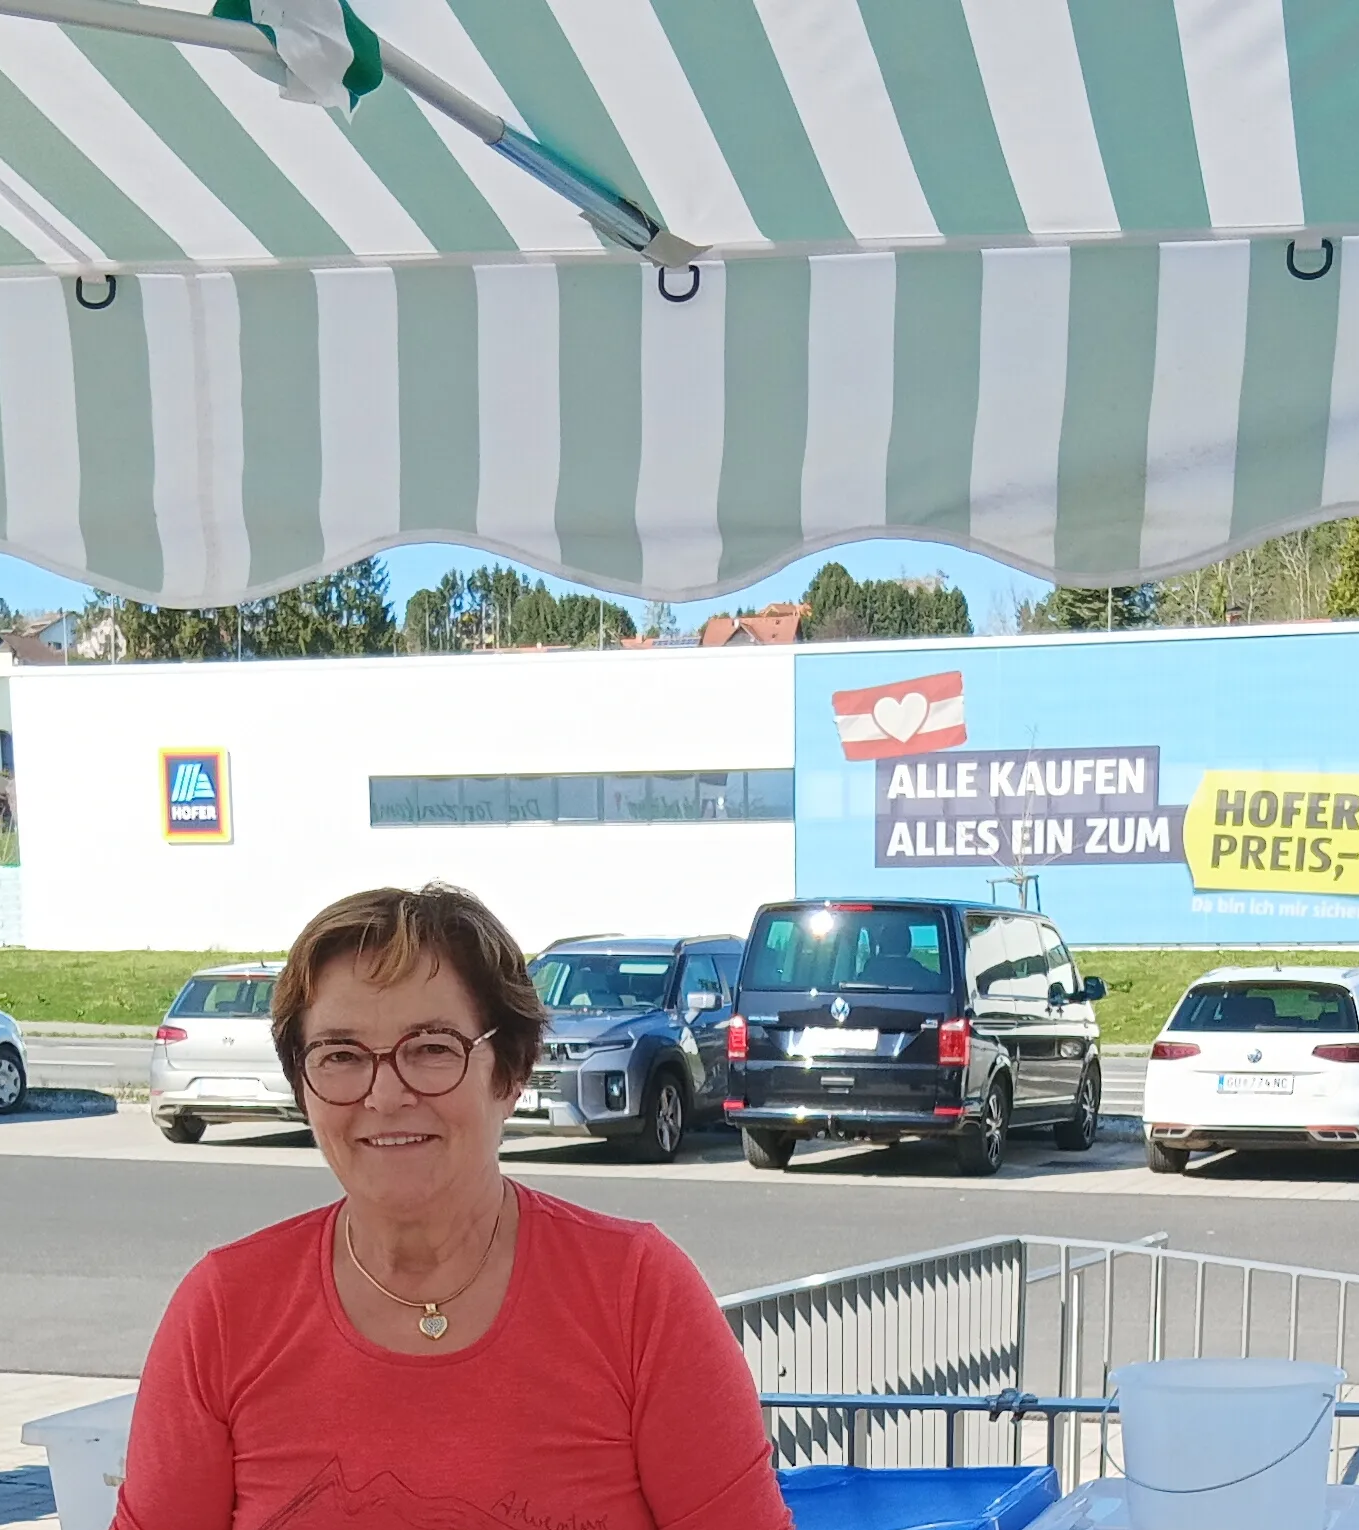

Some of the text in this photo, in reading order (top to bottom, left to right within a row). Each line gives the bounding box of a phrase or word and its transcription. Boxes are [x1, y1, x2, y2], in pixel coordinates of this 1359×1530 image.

[887, 757, 1146, 800] ALLE KAUFEN
[171, 805, 217, 821] HOFER
[886, 816, 1171, 857] ALLES EIN ZUM
[1191, 895, 1213, 912] Da
[1216, 896, 1245, 914] bin
[1278, 901, 1309, 917] mir
